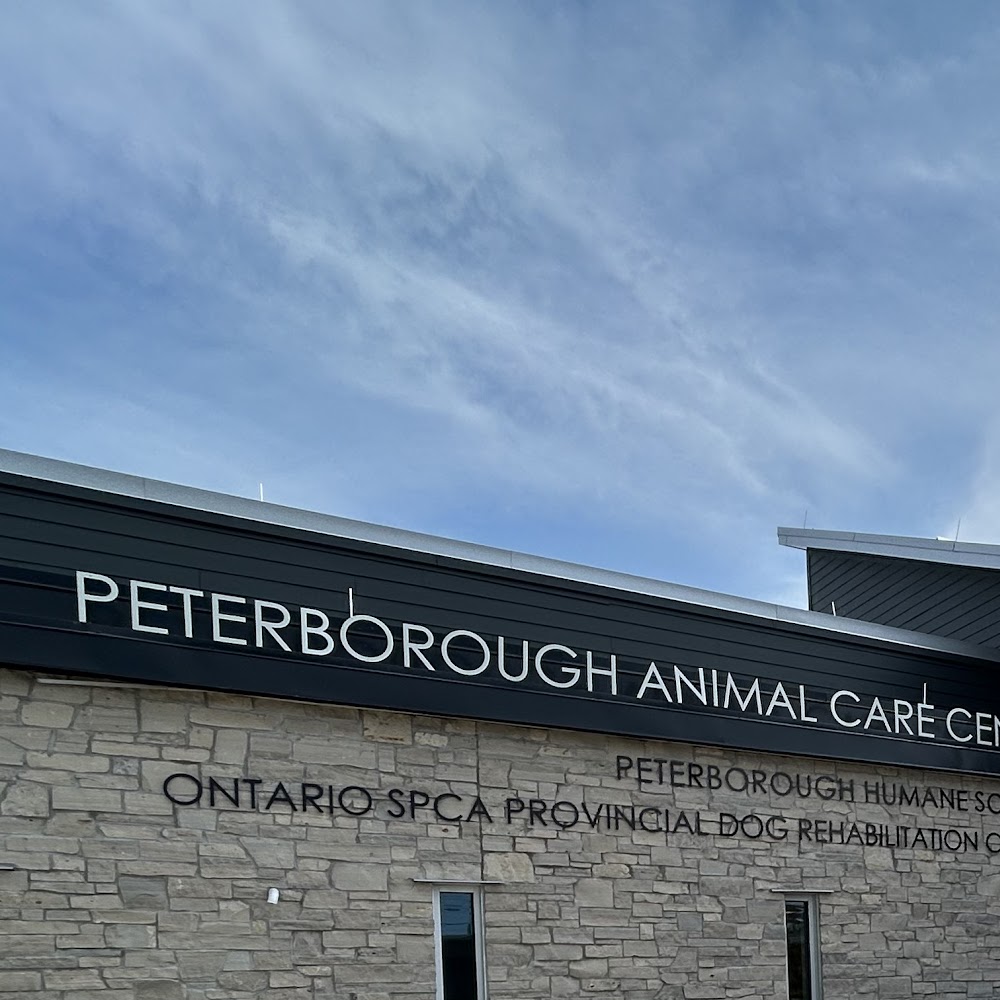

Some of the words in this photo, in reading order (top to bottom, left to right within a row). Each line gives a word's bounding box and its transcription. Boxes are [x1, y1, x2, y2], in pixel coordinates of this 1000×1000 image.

[75, 570, 618, 696] PETERBOROUGH
[636, 661, 817, 722] ANIMAL
[830, 690, 935, 738] CARE
[163, 773, 374, 816] ONTARIO
[386, 788, 494, 825] SPCA
[506, 798, 707, 837] PROVINCIAL
[718, 811, 789, 841] DOG
[798, 819, 979, 853] REHABILITATION
[616, 755, 854, 802] PETERBOROUGH
[863, 781, 972, 813] HUMANE
